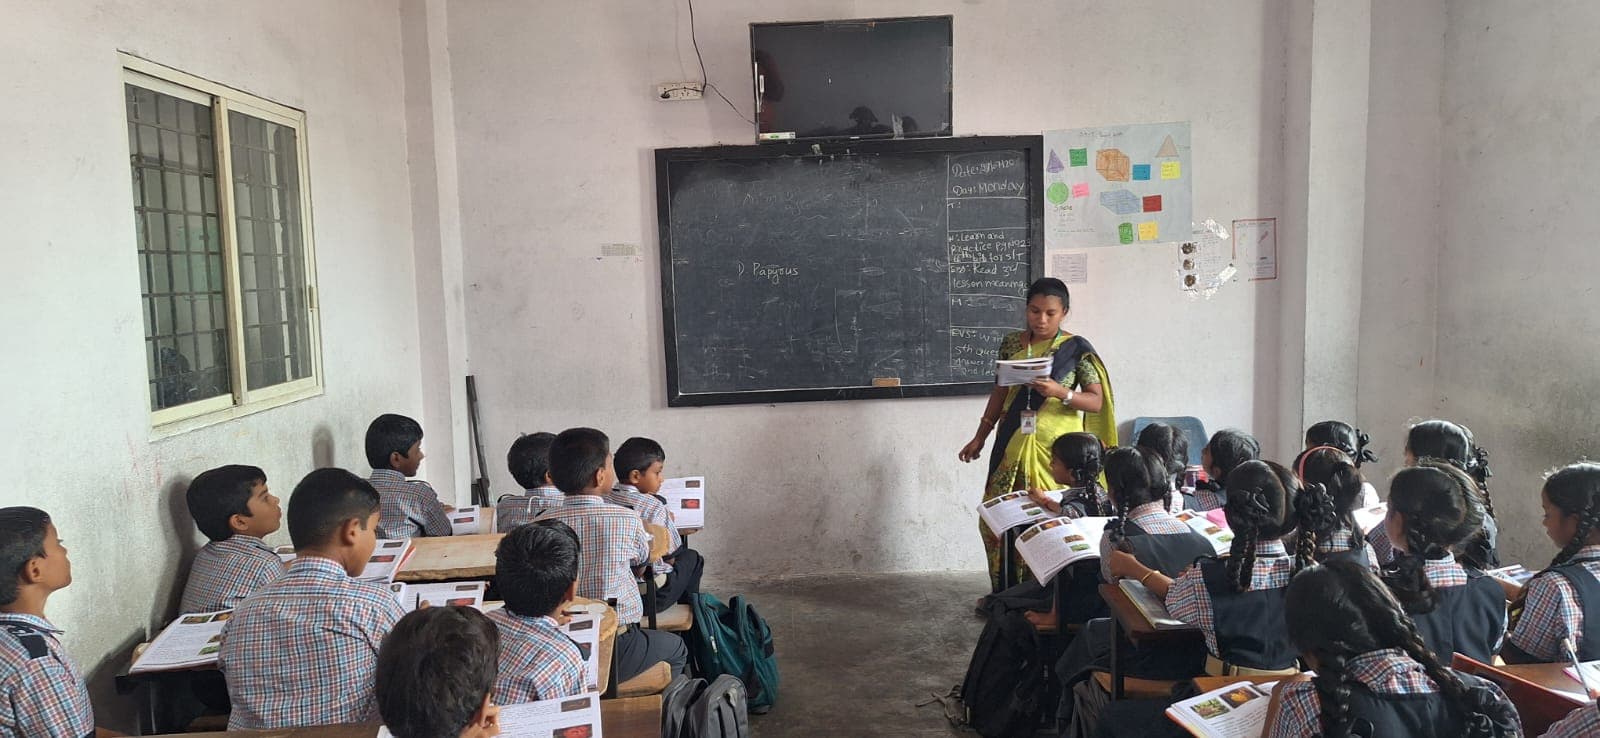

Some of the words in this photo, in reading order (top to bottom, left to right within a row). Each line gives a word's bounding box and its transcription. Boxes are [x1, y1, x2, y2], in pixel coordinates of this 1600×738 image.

[979, 179, 1024, 196] Monday
[988, 231, 1005, 240] and
[953, 279, 983, 288] lesson
